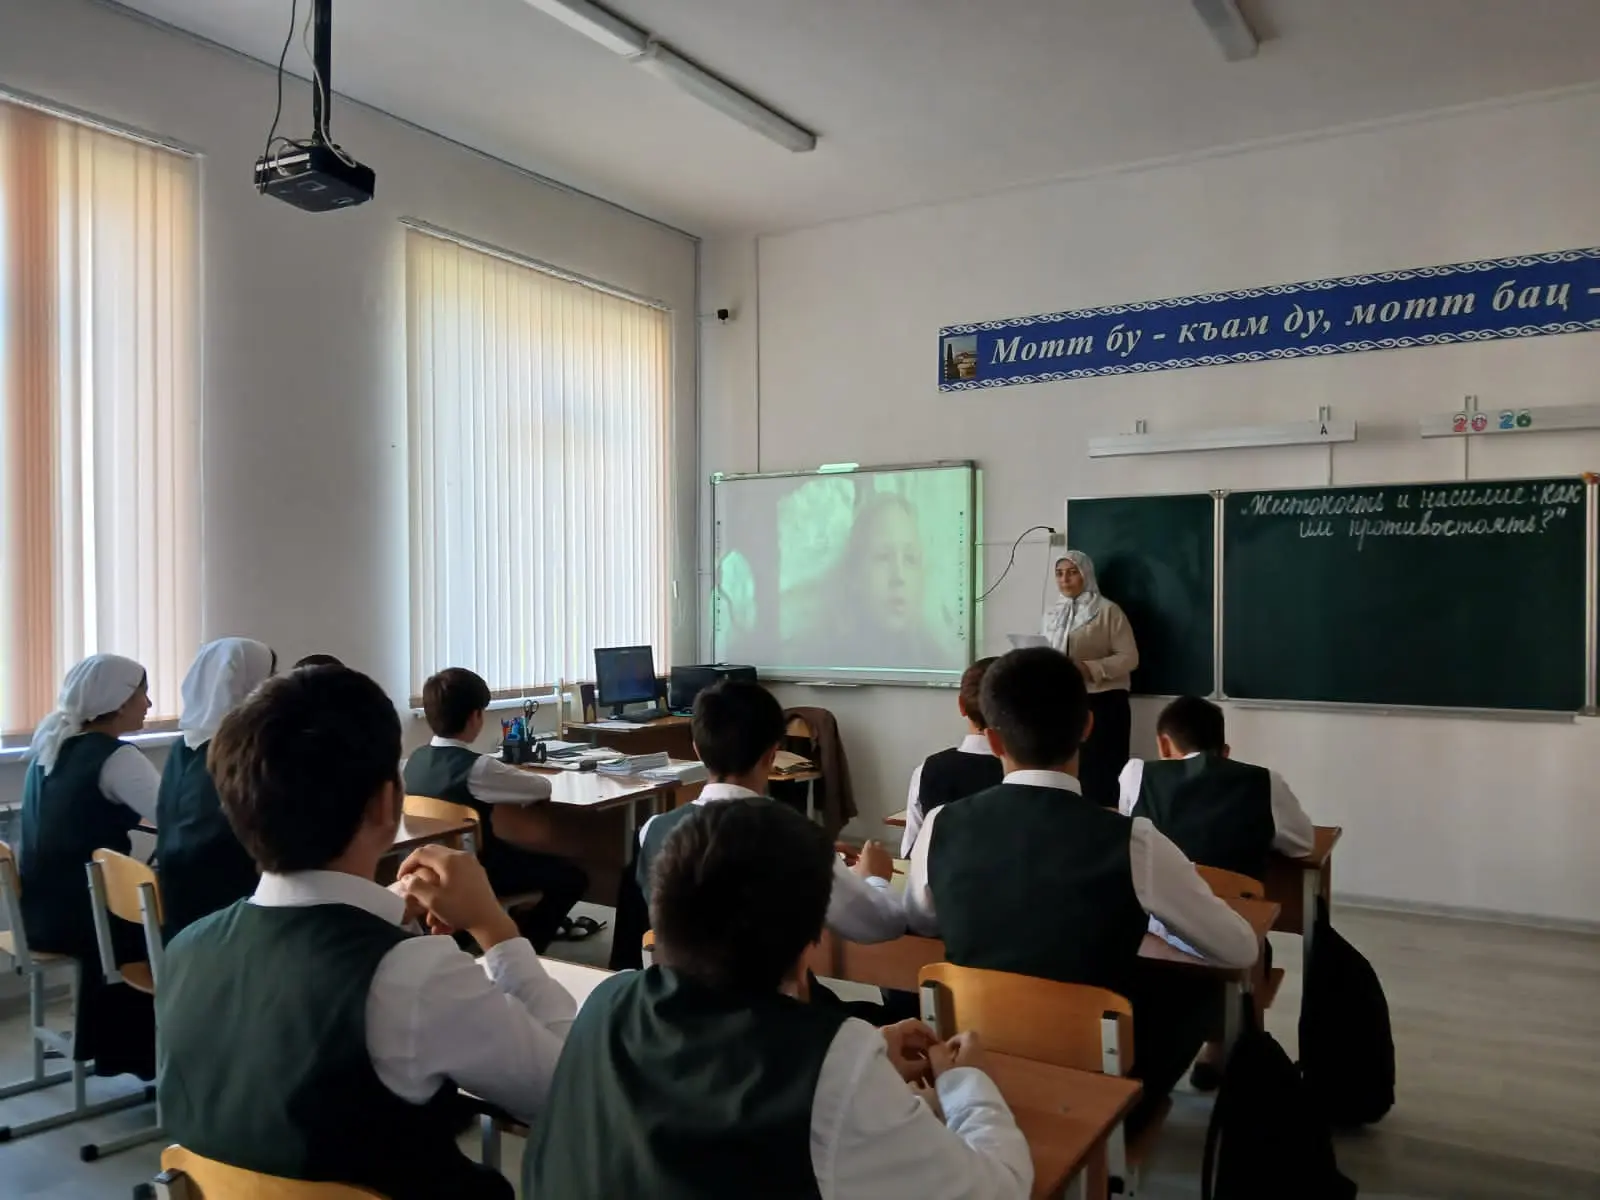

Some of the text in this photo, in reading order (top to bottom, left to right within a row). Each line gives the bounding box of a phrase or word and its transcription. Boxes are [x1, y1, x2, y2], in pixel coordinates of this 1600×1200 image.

[990, 334, 1093, 364] Мотт
[1106, 323, 1142, 357] бу
[1178, 314, 1270, 344] къам
[1283, 303, 1332, 339] ду,
[1345, 291, 1476, 326] мотт
[1492, 279, 1572, 312] бац
[1396, 494, 1410, 509] и
[1540, 484, 1582, 505] как
